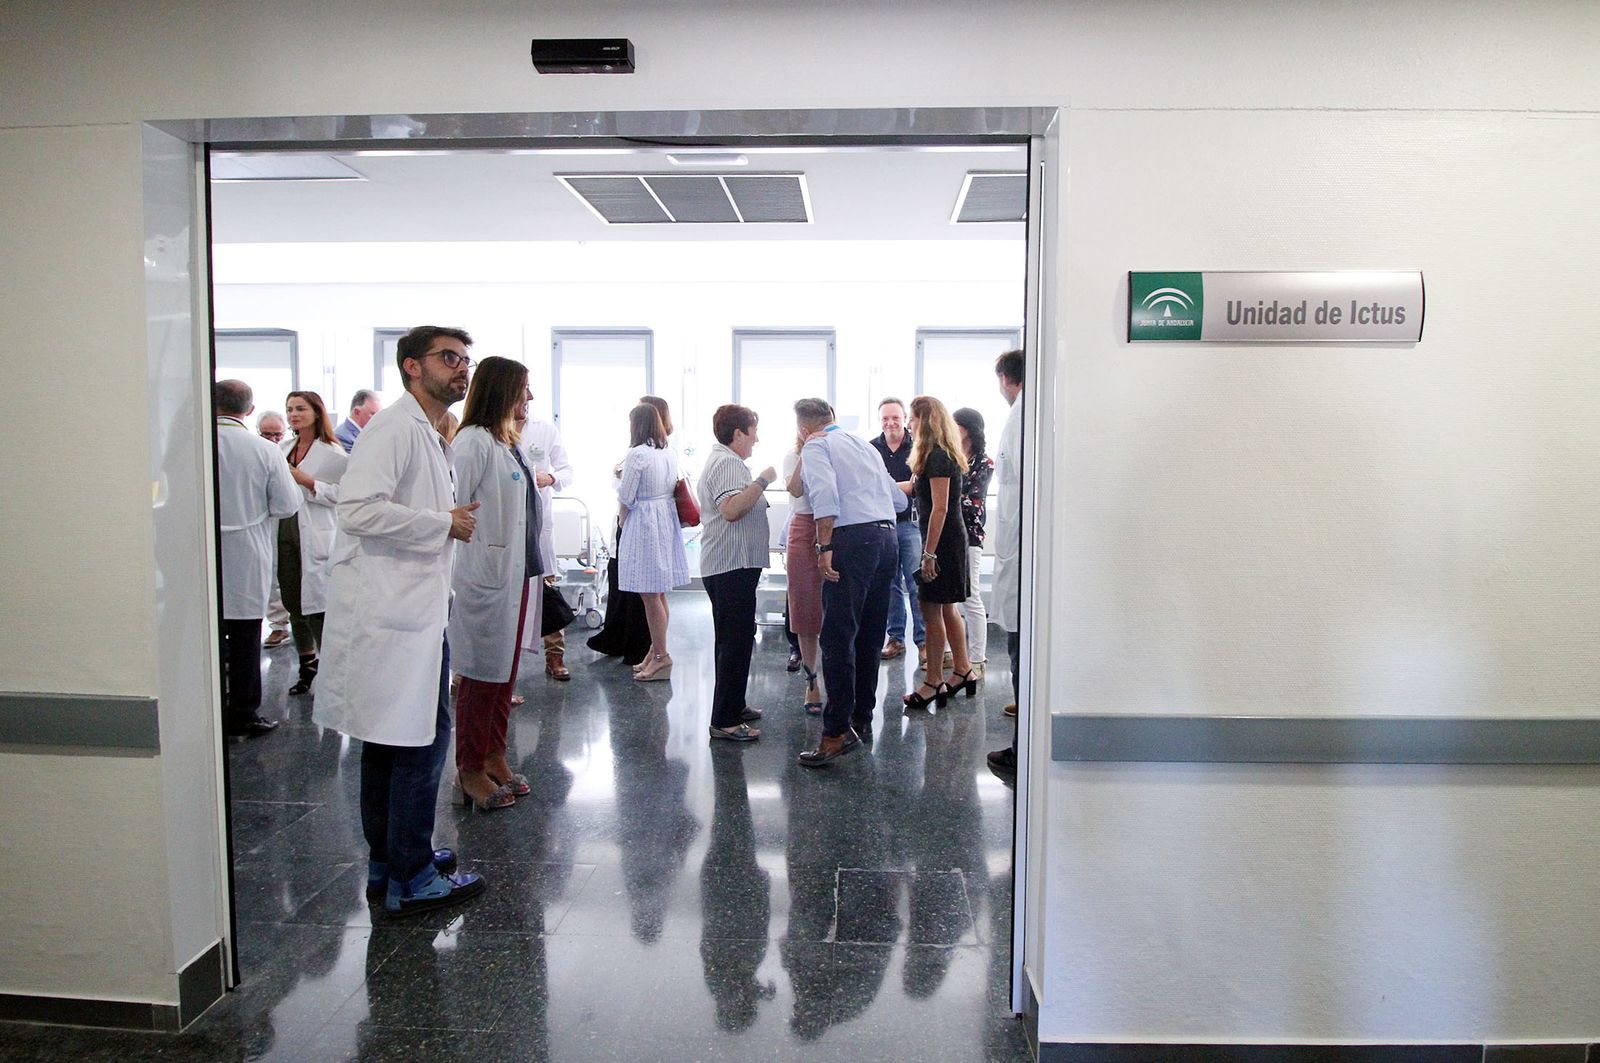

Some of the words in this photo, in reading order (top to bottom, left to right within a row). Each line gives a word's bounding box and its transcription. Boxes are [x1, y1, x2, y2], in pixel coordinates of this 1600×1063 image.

[1227, 300, 1307, 326] Unidad
[1314, 300, 1341, 326] de
[1350, 300, 1406, 326] Ictus
[1139, 319, 1157, 327] JUNTA
